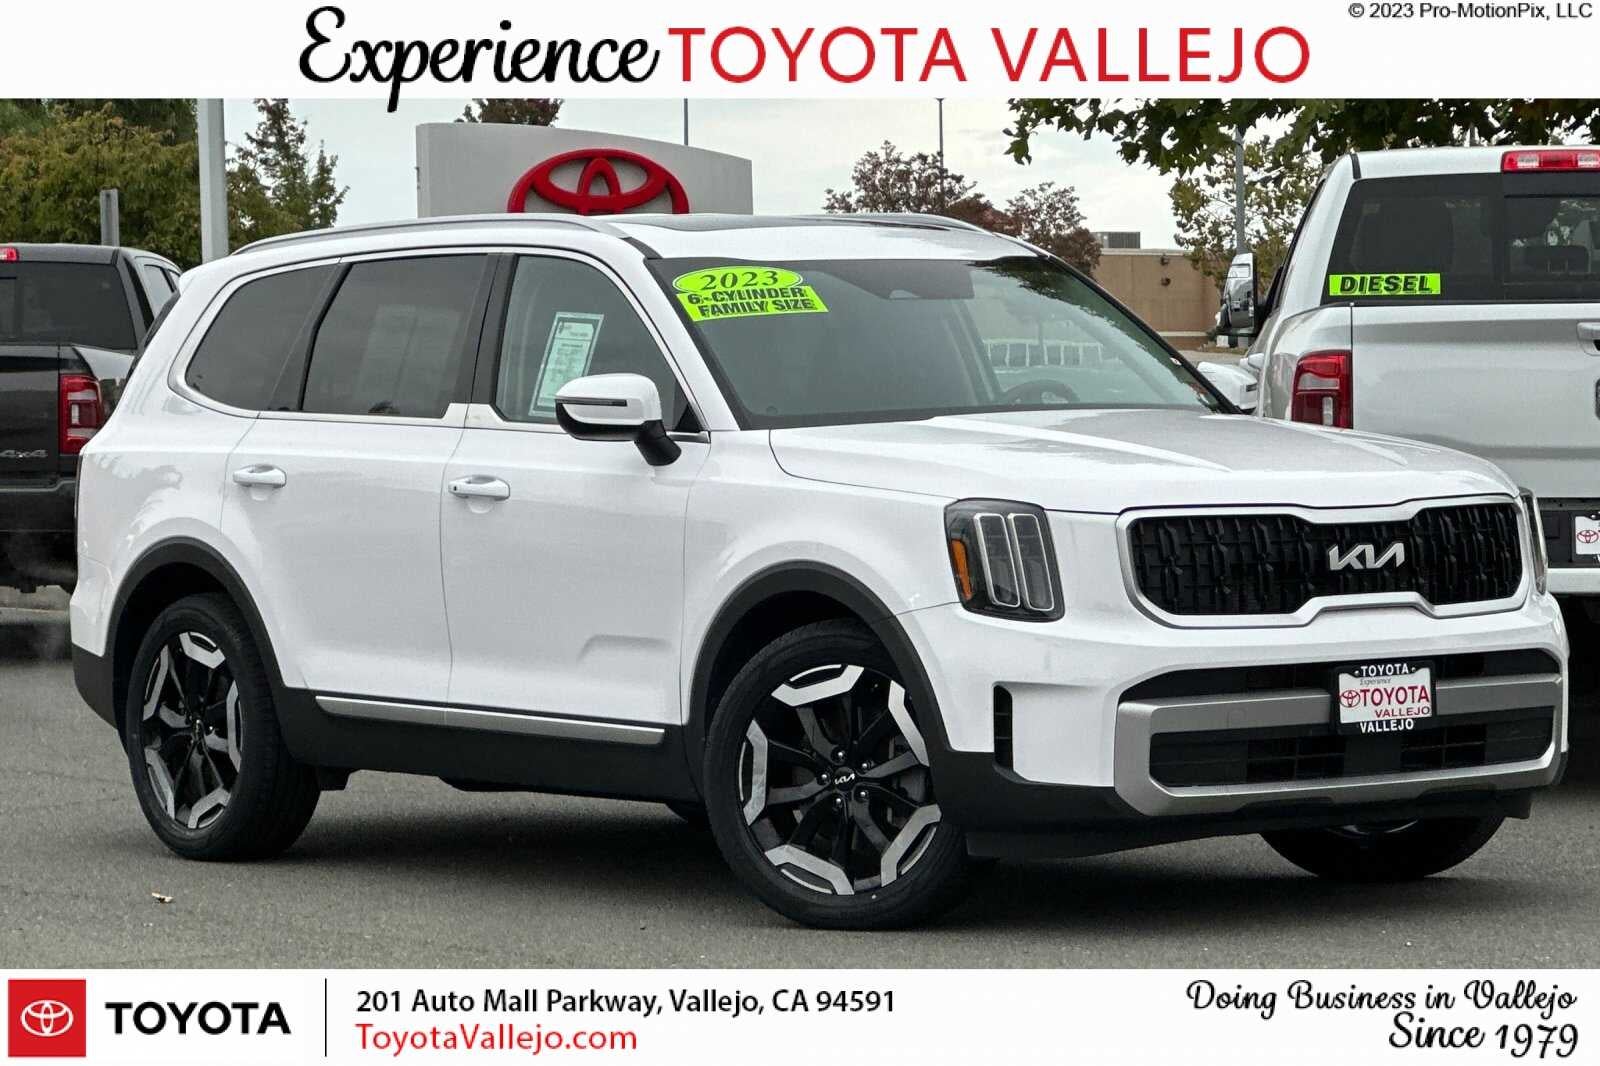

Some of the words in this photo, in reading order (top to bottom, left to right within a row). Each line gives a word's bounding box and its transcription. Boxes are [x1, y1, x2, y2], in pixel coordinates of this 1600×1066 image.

[700, 270, 779, 291] 2023
[1339, 275, 1433, 294] DIESEL
[687, 287, 806, 305] 6-CYLINDER
[698, 301, 769, 318] FAMILY
[771, 298, 818, 311] SIZE
[1360, 663, 1409, 677] TOYOTA
[1360, 685, 1430, 707] TOYOTA
[1375, 706, 1430, 718] VALLEJO
[1360, 718, 1414, 734] VALLEJO
